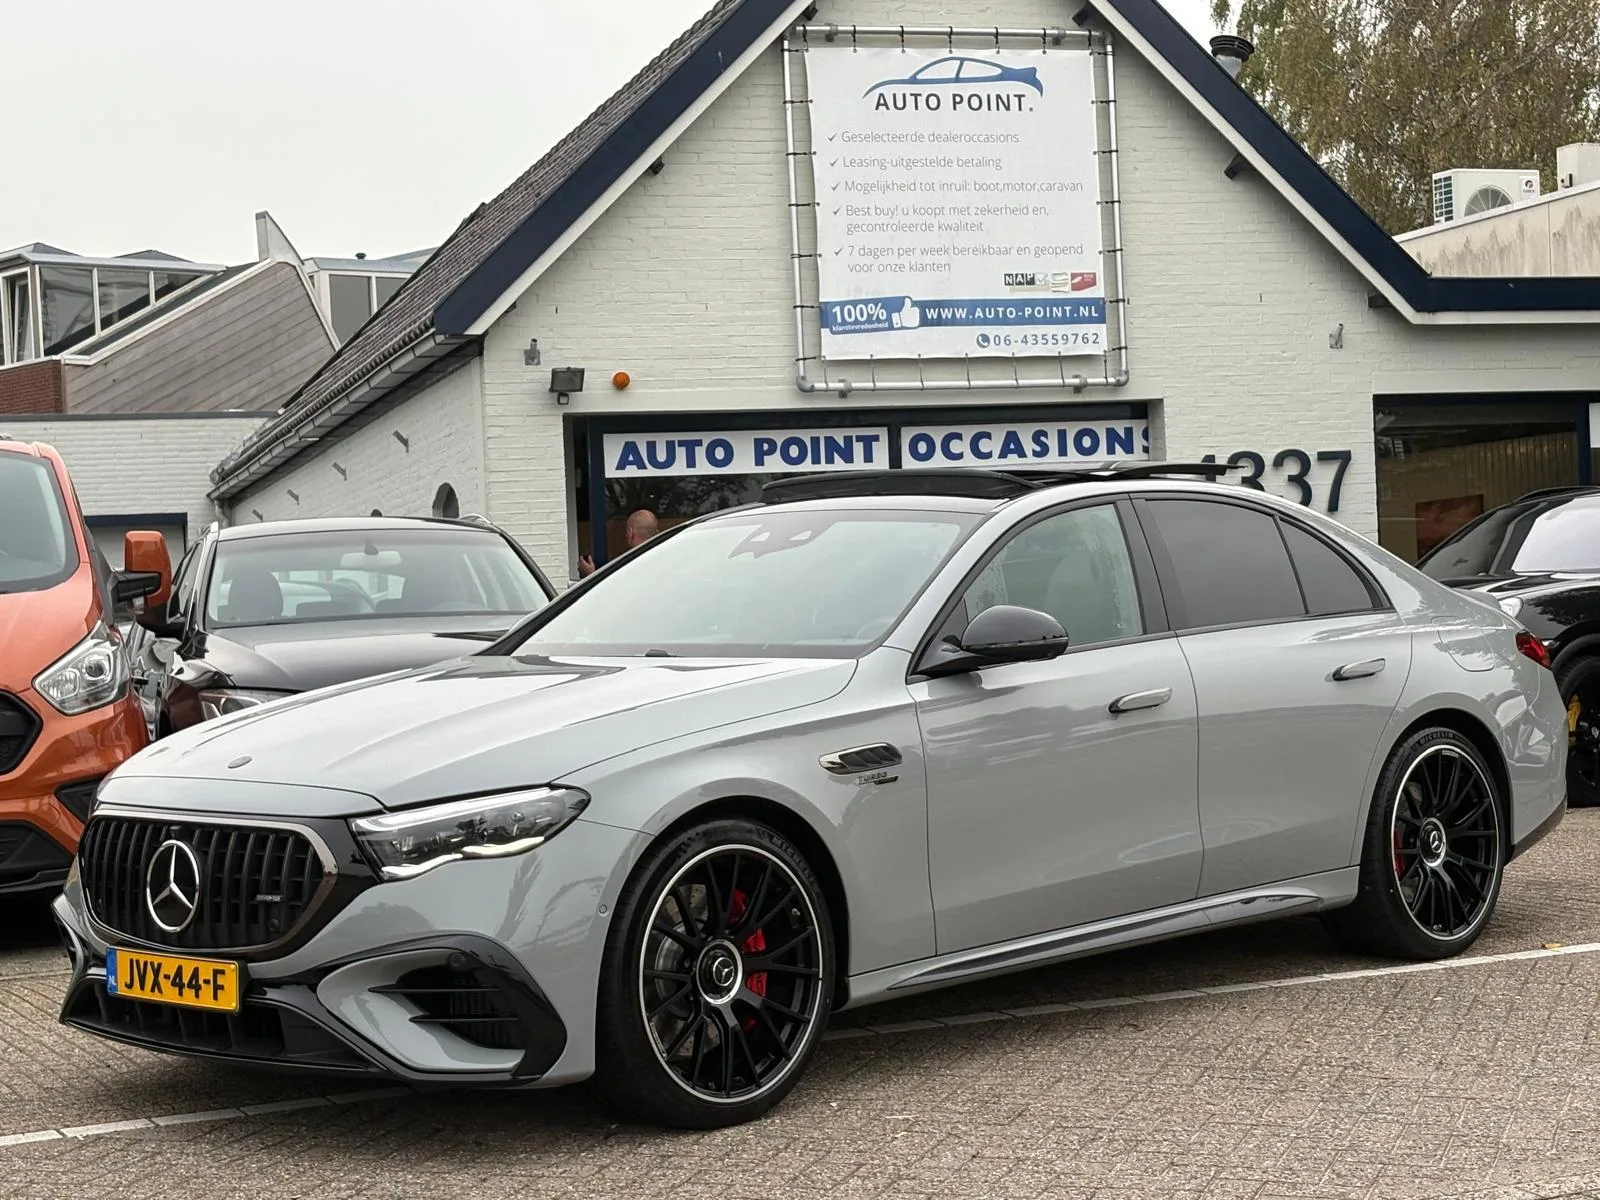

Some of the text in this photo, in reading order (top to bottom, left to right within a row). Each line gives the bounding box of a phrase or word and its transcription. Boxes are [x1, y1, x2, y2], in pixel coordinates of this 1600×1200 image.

[874, 92, 1034, 112] AUTO POINT.
[841, 130, 1020, 143] Geselecteerde dealeroccasions
[843, 156, 1002, 171] Leasing-uitgestelde betaling
[844, 180, 1084, 195] Mogelijkheid tot inruil: boot,motor,caravan
[846, 204, 1049, 219] Best buy! u koopt met zekerheid en,
[846, 220, 984, 236] gecontroleerde kwaliteit
[847, 244, 1084, 260] 7 dagen per week bereikbaar en geopend
[847, 260, 952, 273] voor onze klanten
[1004, 272, 1035, 286] NAP
[832, 302, 888, 323] 100%
[925, 305, 1099, 320] WWW.AUTO-POINT.NL
[993, 332, 1100, 347] 06-43559762
[615, 434, 880, 471] AUTO POINT
[124, 957, 226, 1002] JVX-44-F
